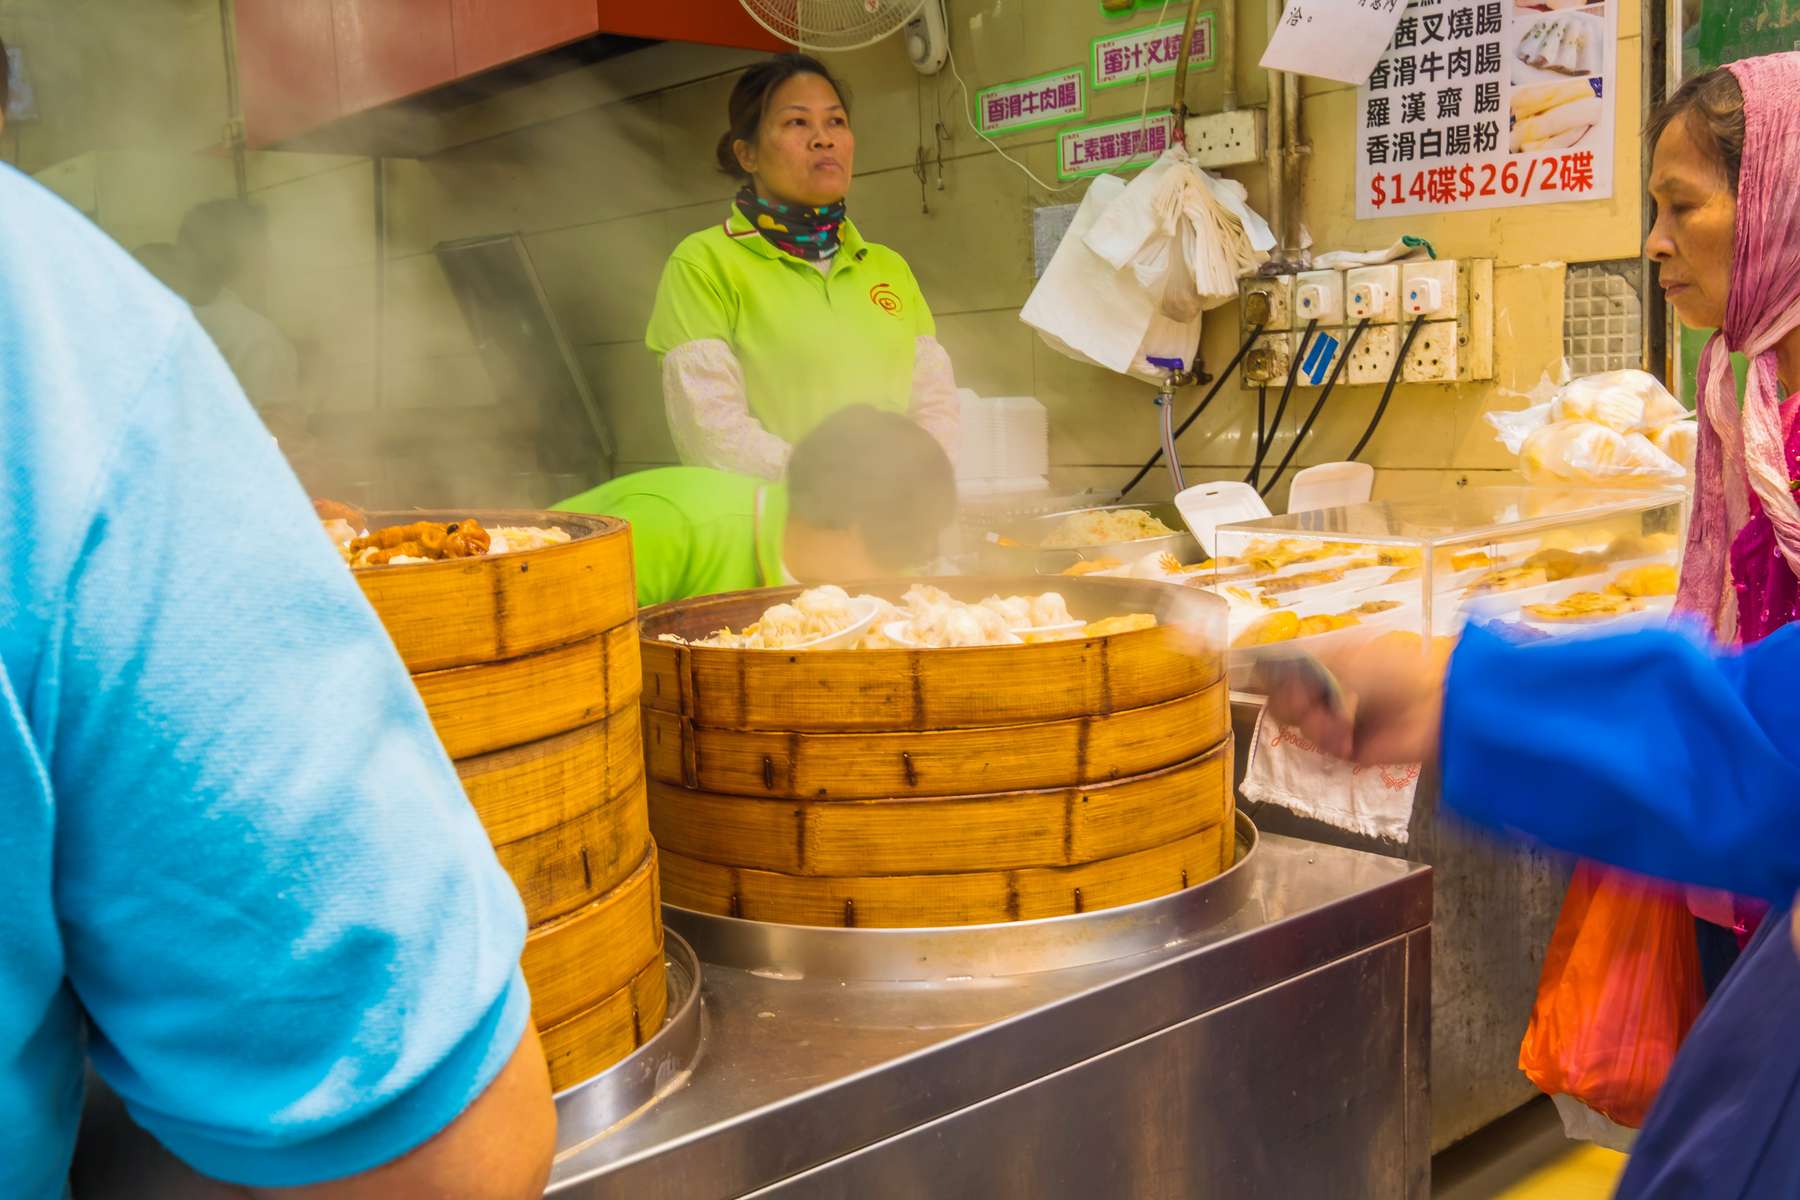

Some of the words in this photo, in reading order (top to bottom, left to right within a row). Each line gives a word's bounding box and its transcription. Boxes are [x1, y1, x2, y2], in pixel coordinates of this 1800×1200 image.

[1386, 2, 1502, 50] 茜叉燒腸
[1369, 42, 1502, 91] 香滑牛肉腸
[988, 82, 1076, 123] 香滑牛肉腸
[1366, 81, 1500, 128] 羅漢齋腸
[1366, 120, 1499, 165] 香滑白腸粉
